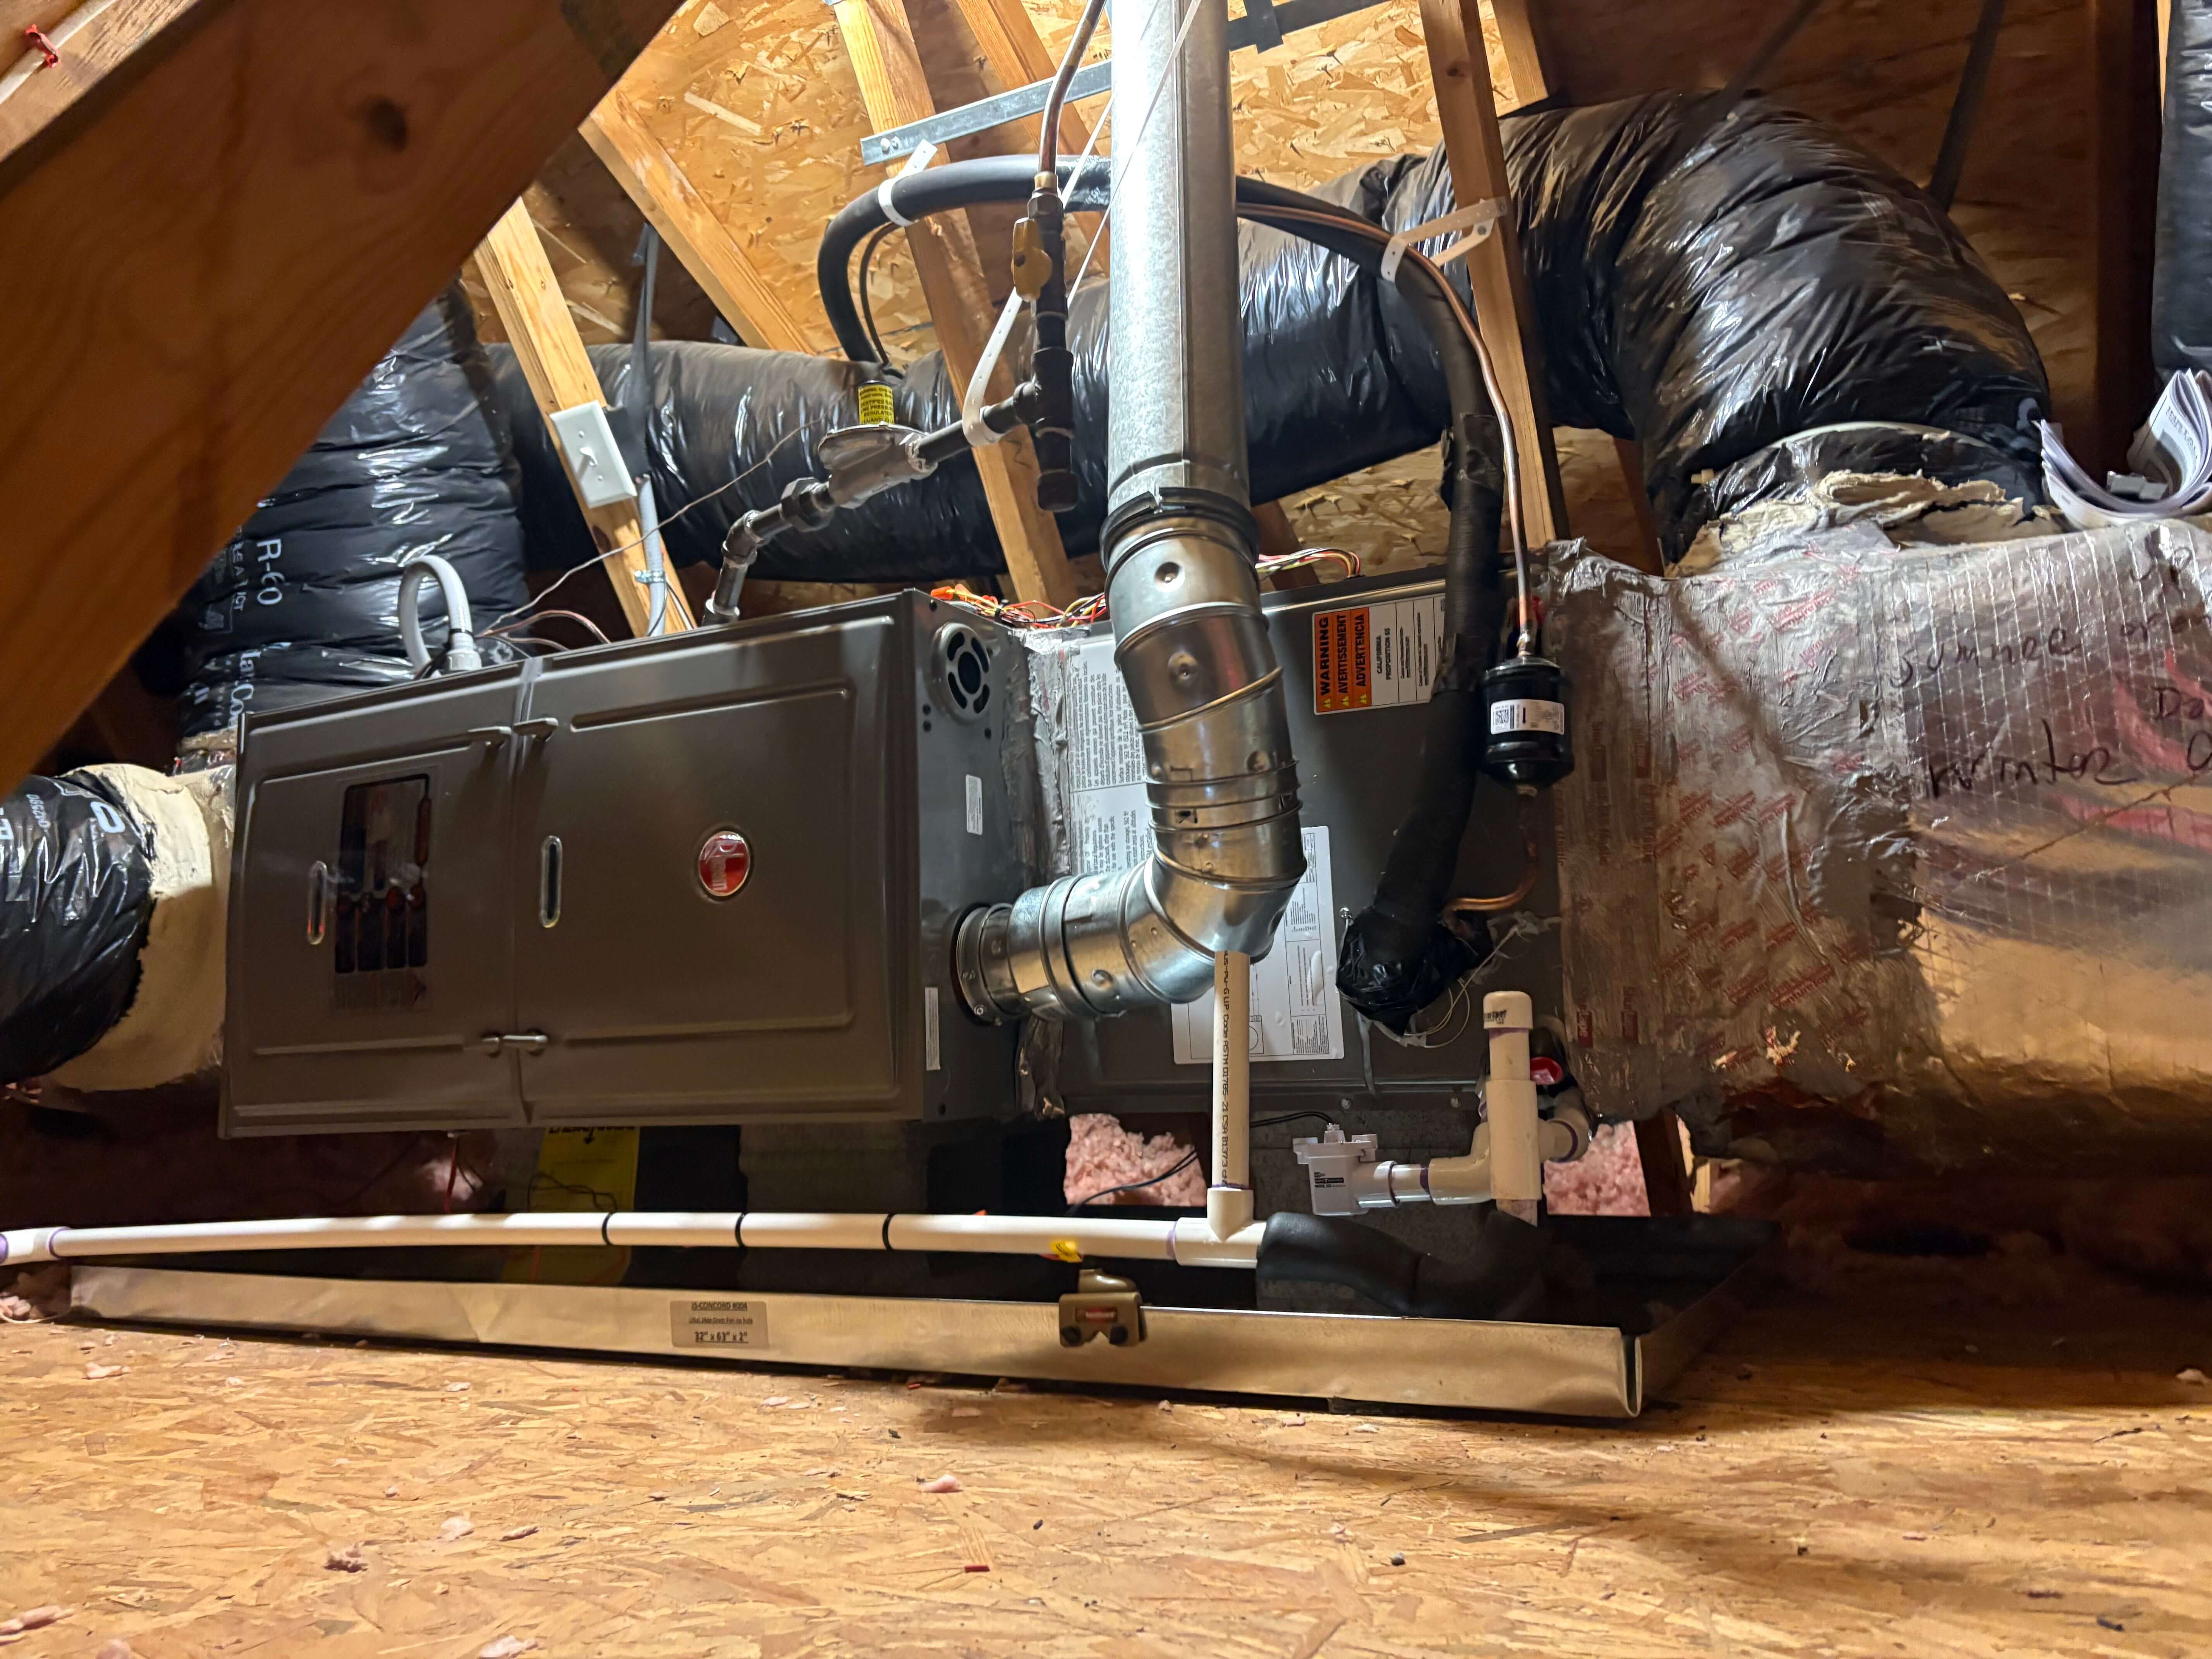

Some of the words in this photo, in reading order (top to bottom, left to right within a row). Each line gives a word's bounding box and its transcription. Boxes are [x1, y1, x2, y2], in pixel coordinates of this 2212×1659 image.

[1319, 617, 1330, 696] WARNING
[1337, 615, 1348, 694] AVERTISSEMENT
[1355, 613, 1366, 687] ADVERTENCIA
